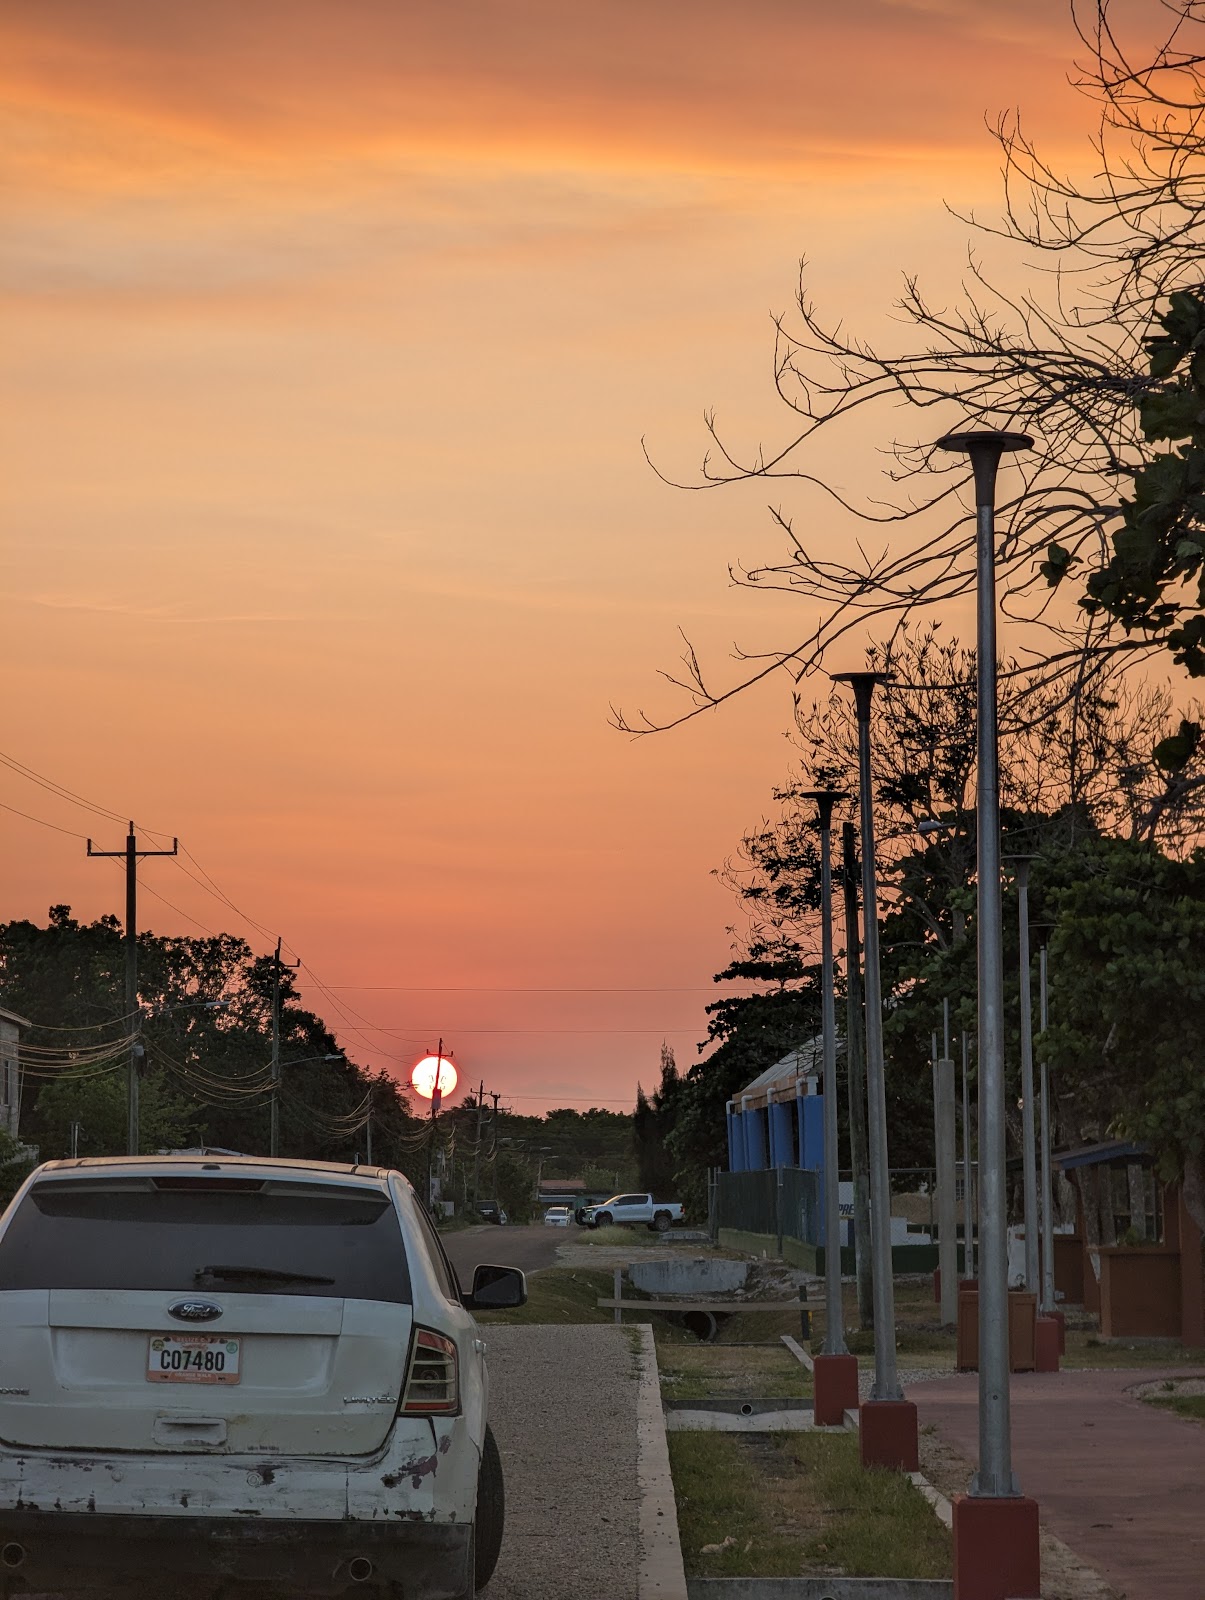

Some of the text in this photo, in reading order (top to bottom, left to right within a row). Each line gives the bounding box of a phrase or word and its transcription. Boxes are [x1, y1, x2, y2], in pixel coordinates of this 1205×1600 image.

[181, 1304, 210, 1317] Ford
[161, 1349, 225, 1371] C07480
[343, 1396, 397, 1404] LIMITED
